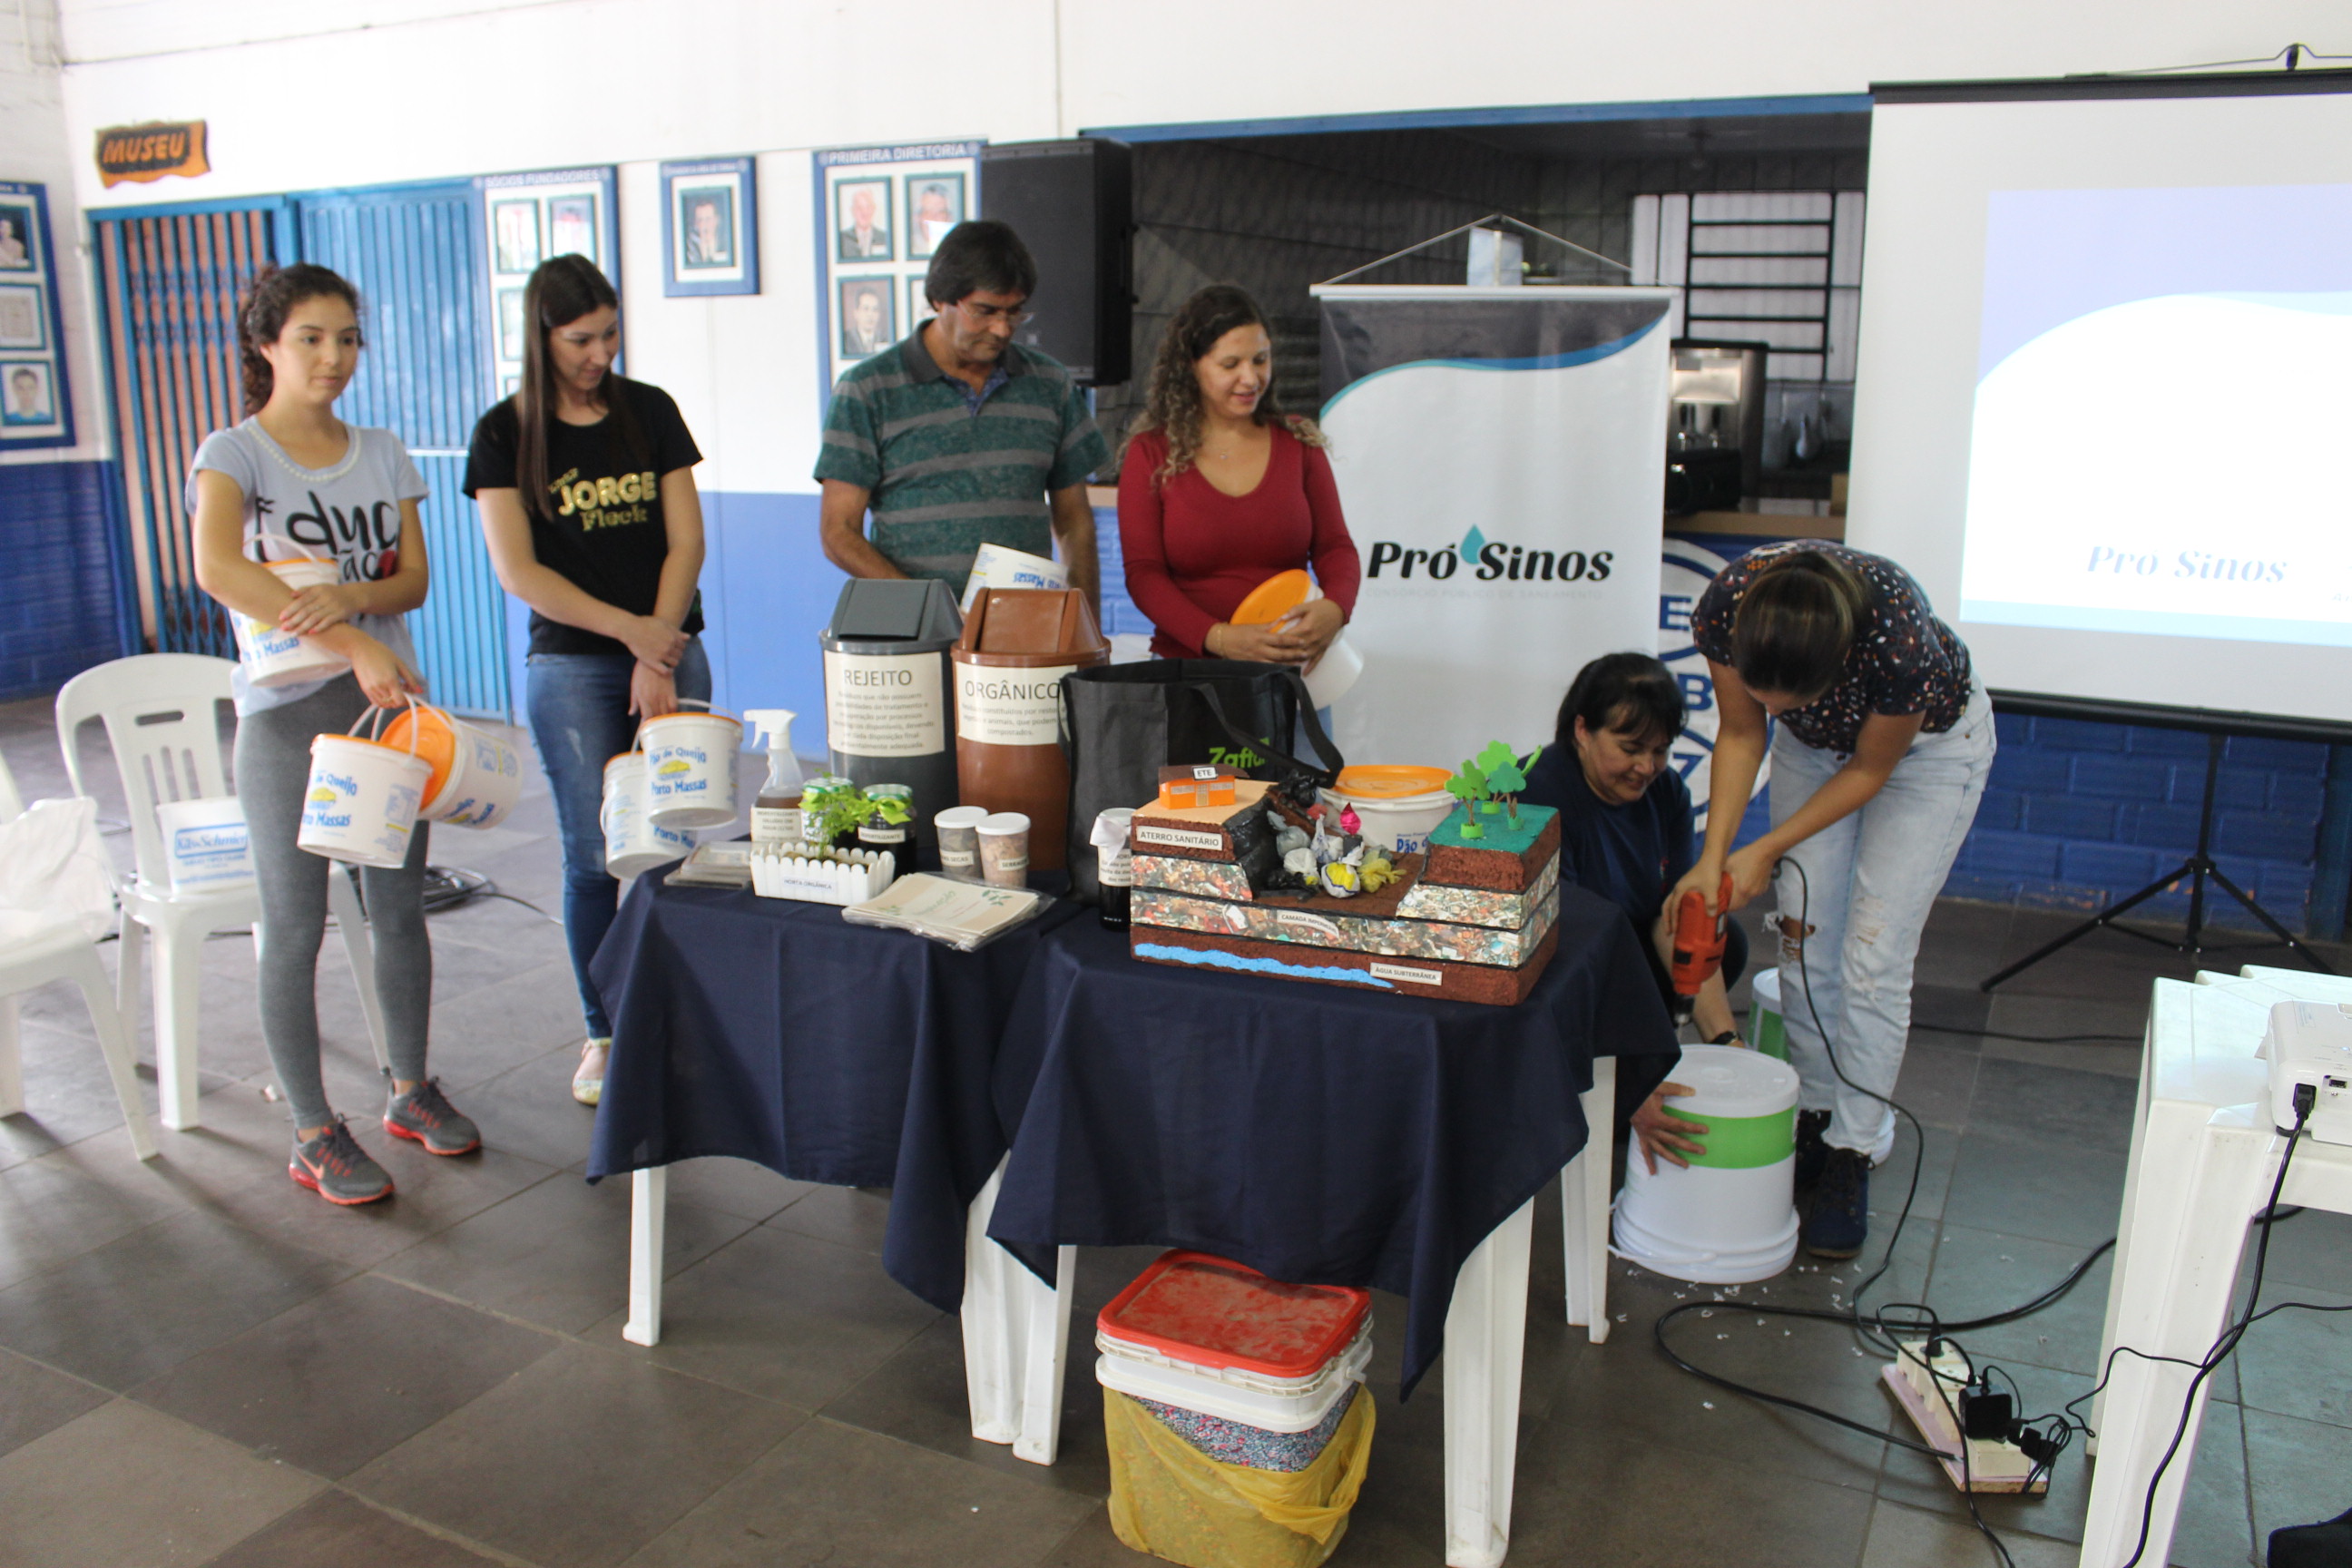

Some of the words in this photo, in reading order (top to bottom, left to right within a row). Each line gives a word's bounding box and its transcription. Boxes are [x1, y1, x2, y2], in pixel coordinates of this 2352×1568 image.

[103, 131, 186, 163] MUSEU
[829, 148, 891, 164] PRIMEIRA
[893, 142, 965, 161] DIRETORIA
[558, 471, 657, 516] JORGE
[580, 505, 648, 532] Fleck
[1367, 542, 1457, 580] Pró
[1475, 542, 1613, 582] Sinos
[2086, 545, 2160, 576] Pró
[2173, 549, 2288, 583] Sinos
[844, 670, 912, 687] REJEITO
[965, 679, 1060, 701] ORGÂNICO
[1197, 769, 1212, 778] ETE
[326, 773, 358, 796] Queijo
[674, 779, 707, 793] Massas
[316, 812, 352, 828] Massas
[652, 826, 679, 842] Porto
[1140, 831, 1172, 841] ATERRO
[1174, 835, 1220, 847] SANITÁRIO
[1396, 838, 1417, 854] Pão
[784, 878, 803, 887] HORTA
[804, 880, 833, 889] ORGÂNICA
[1281, 914, 1307, 922] CAMADA
[1376, 965, 1393, 975] ÁGUA
[1394, 969, 1436, 980] SUBTERRÂNEA
